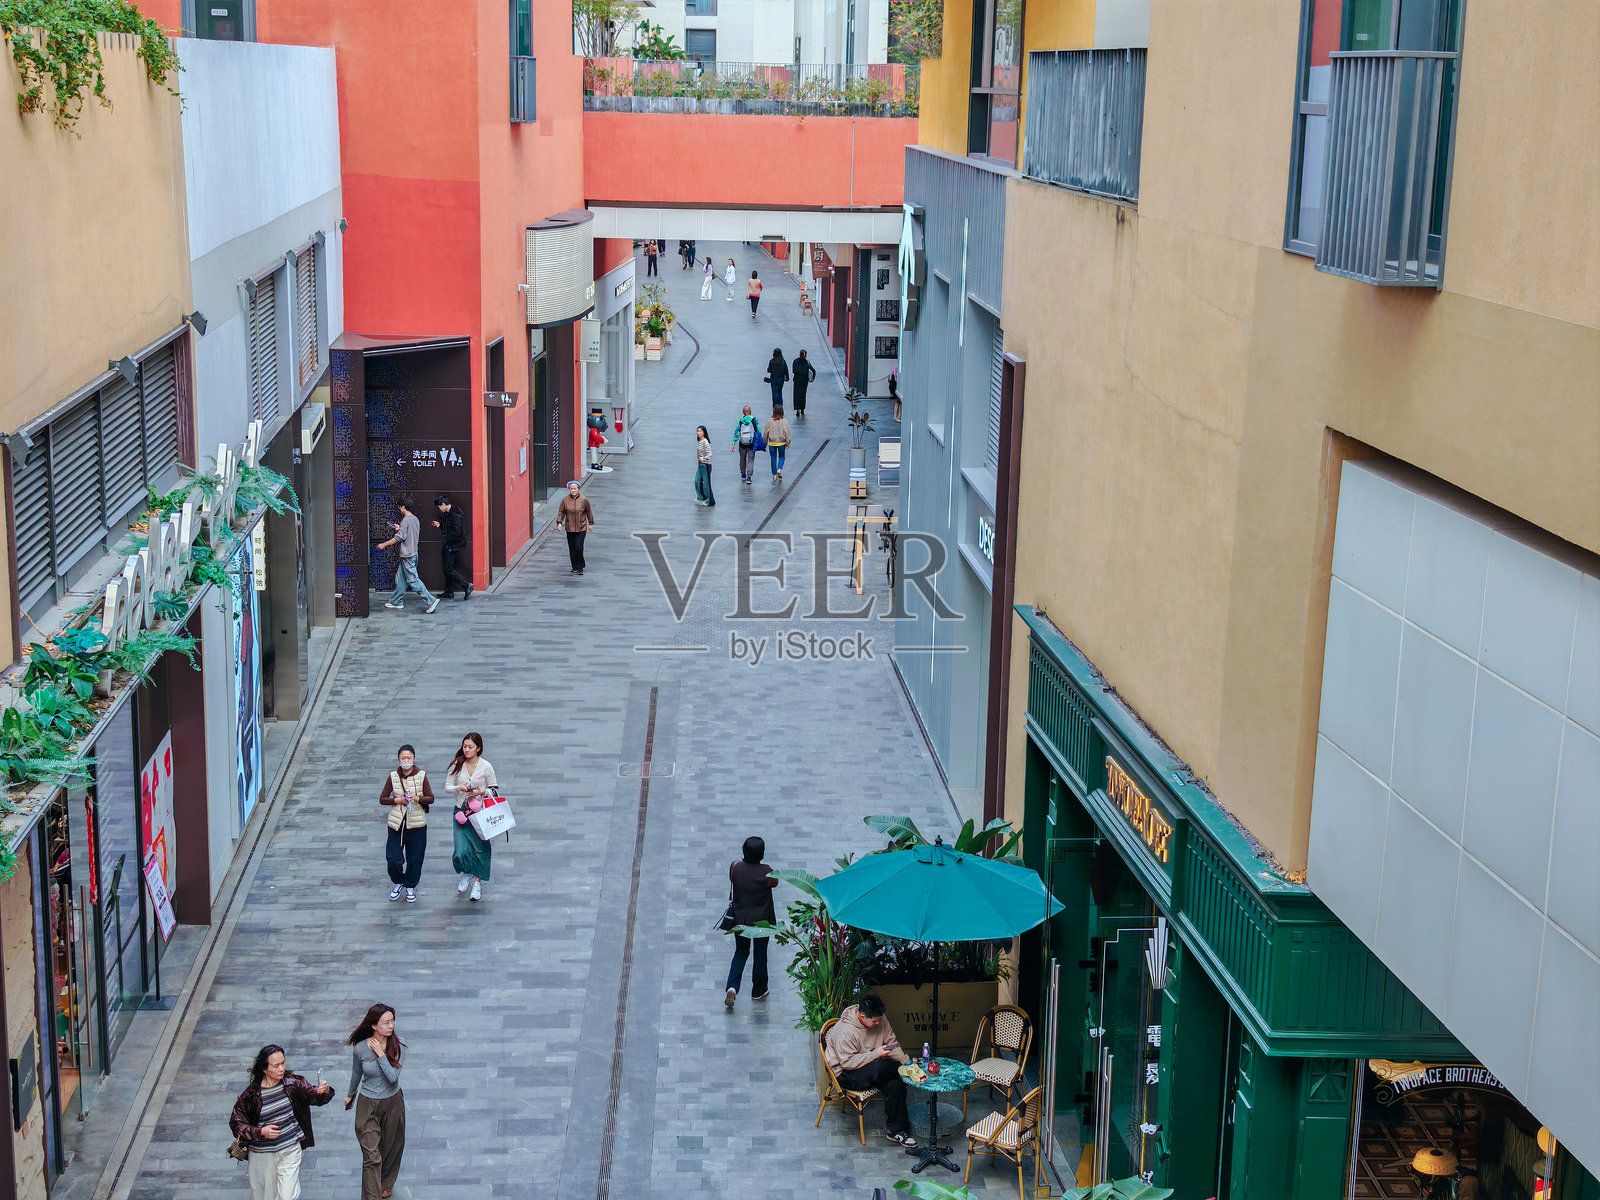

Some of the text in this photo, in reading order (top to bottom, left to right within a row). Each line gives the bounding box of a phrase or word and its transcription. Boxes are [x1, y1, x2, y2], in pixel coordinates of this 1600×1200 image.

[412, 449, 437, 459] 洗手间
[904, 1012, 960, 1022] TWOACE
[1391, 1068, 1442, 1094] TWOFACE
